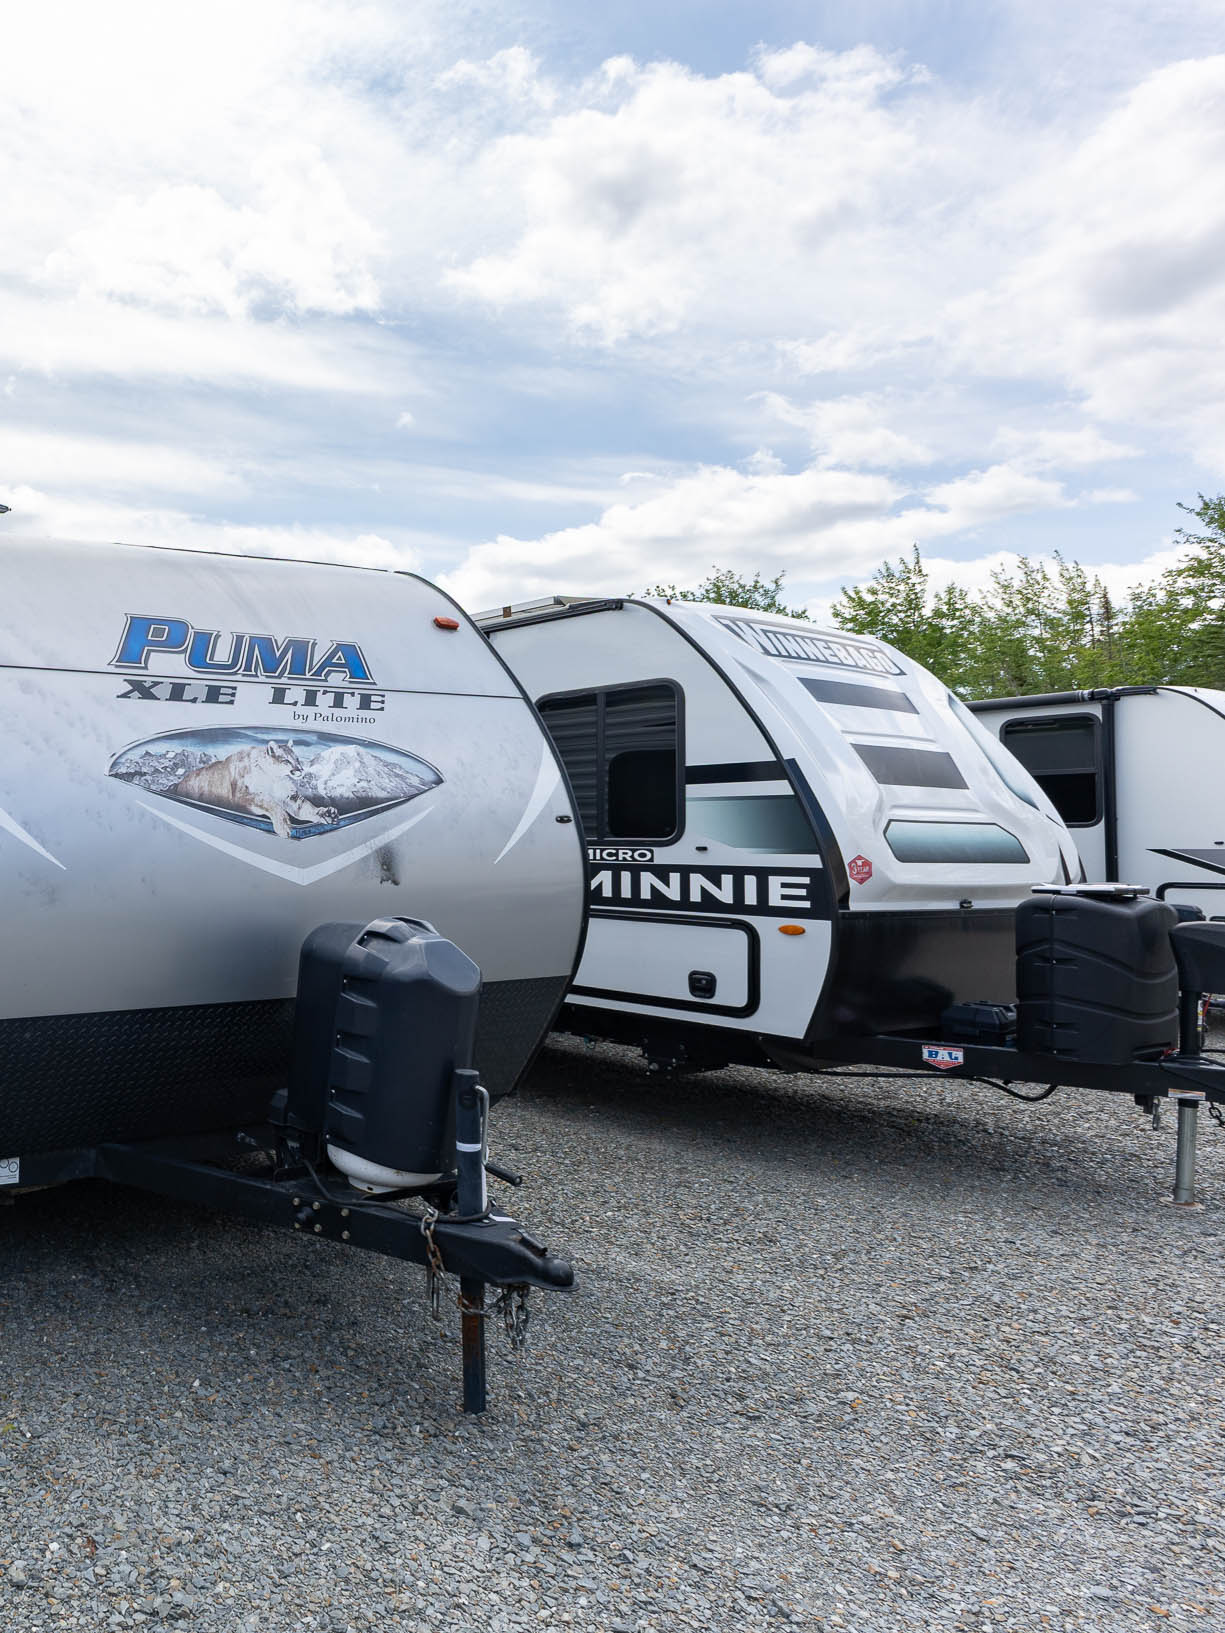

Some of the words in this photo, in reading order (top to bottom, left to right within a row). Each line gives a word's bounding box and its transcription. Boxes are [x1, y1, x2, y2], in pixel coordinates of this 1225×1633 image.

[107, 612, 378, 686] PUMA
[714, 616, 904, 676] WINNEBAGO
[116, 679, 238, 705] XLE
[268, 686, 386, 712] LITE
[293, 711, 309, 724] by
[313, 712, 376, 724] Palomino
